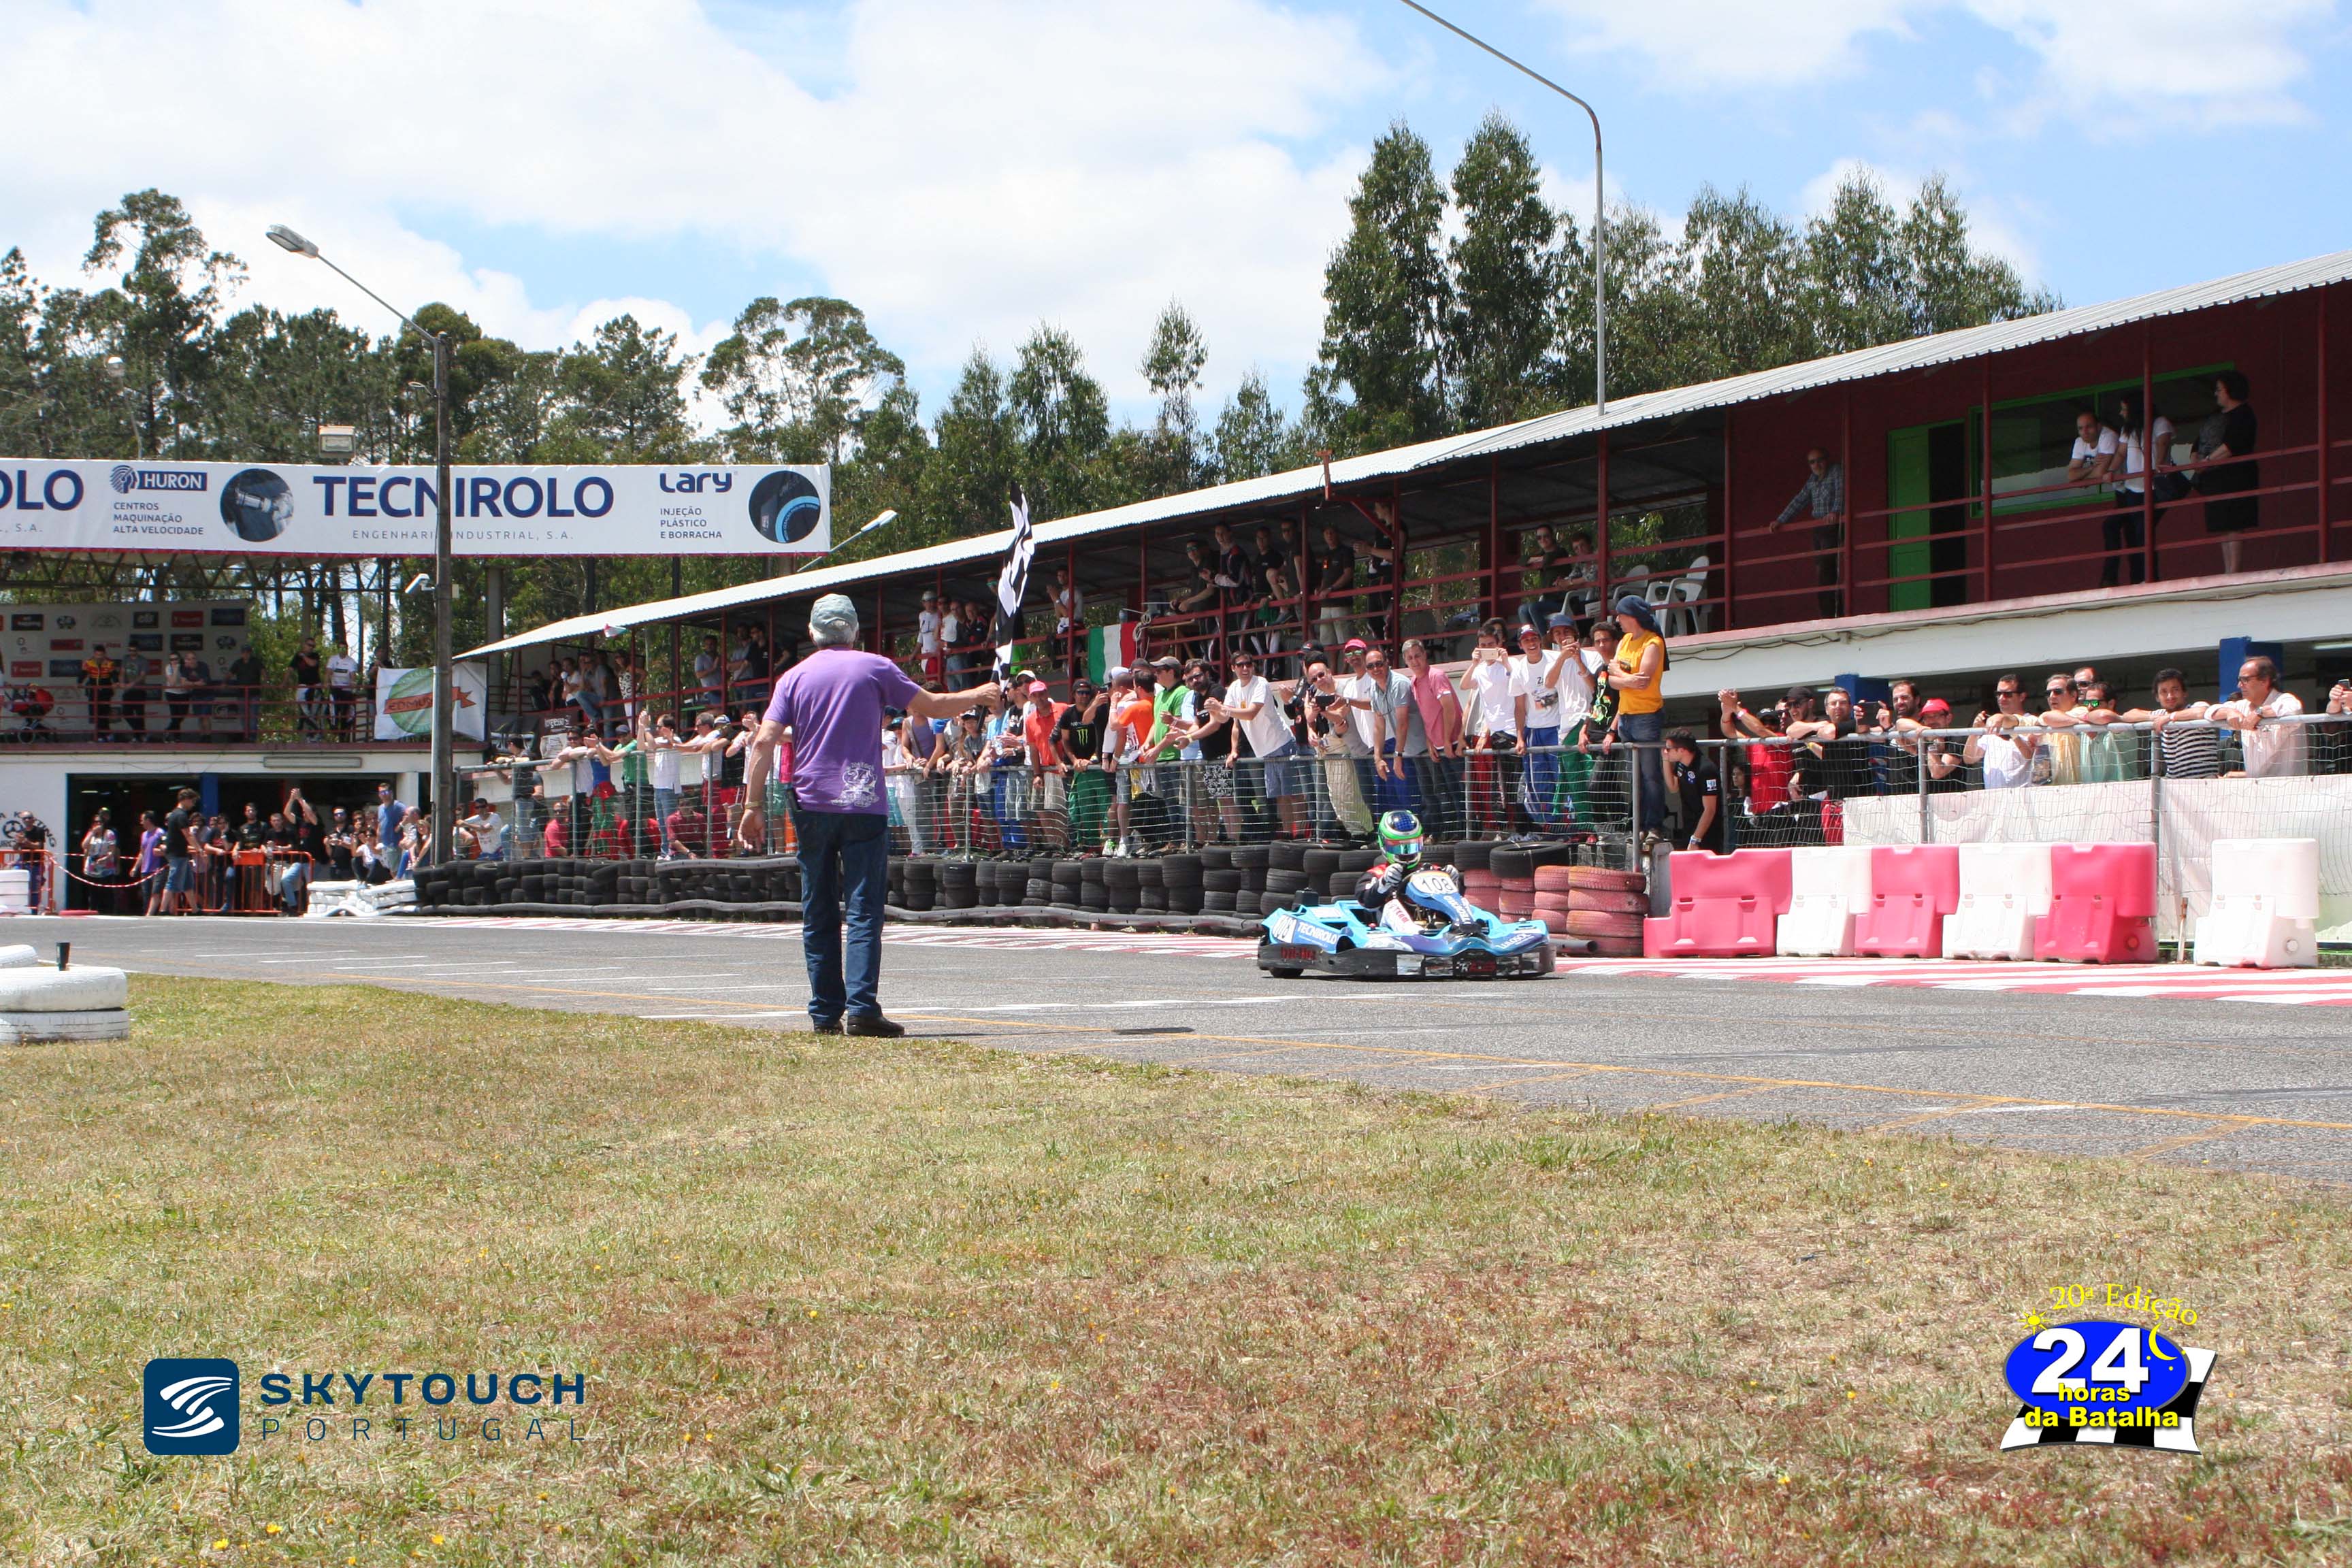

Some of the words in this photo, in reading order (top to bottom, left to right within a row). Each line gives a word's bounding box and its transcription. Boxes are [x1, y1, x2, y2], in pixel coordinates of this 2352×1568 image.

[144, 472, 201, 489] HURON
[313, 476, 614, 518] TECNIROLO
[114, 502, 159, 511] CENTROS
[660, 506, 702, 517] INJEÇÃO
[114, 513, 182, 524] MAQUINAÇÃO
[660, 517, 707, 527] PLÁSTICO
[113, 525, 139, 535] ALTA
[141, 525, 204, 536] VELOCIDADE
[353, 529, 438, 540] ENGENHARI
[546, 530, 574, 540] S.A.
[660, 531, 666, 540] E
[668, 531, 723, 540] BORRACHA
